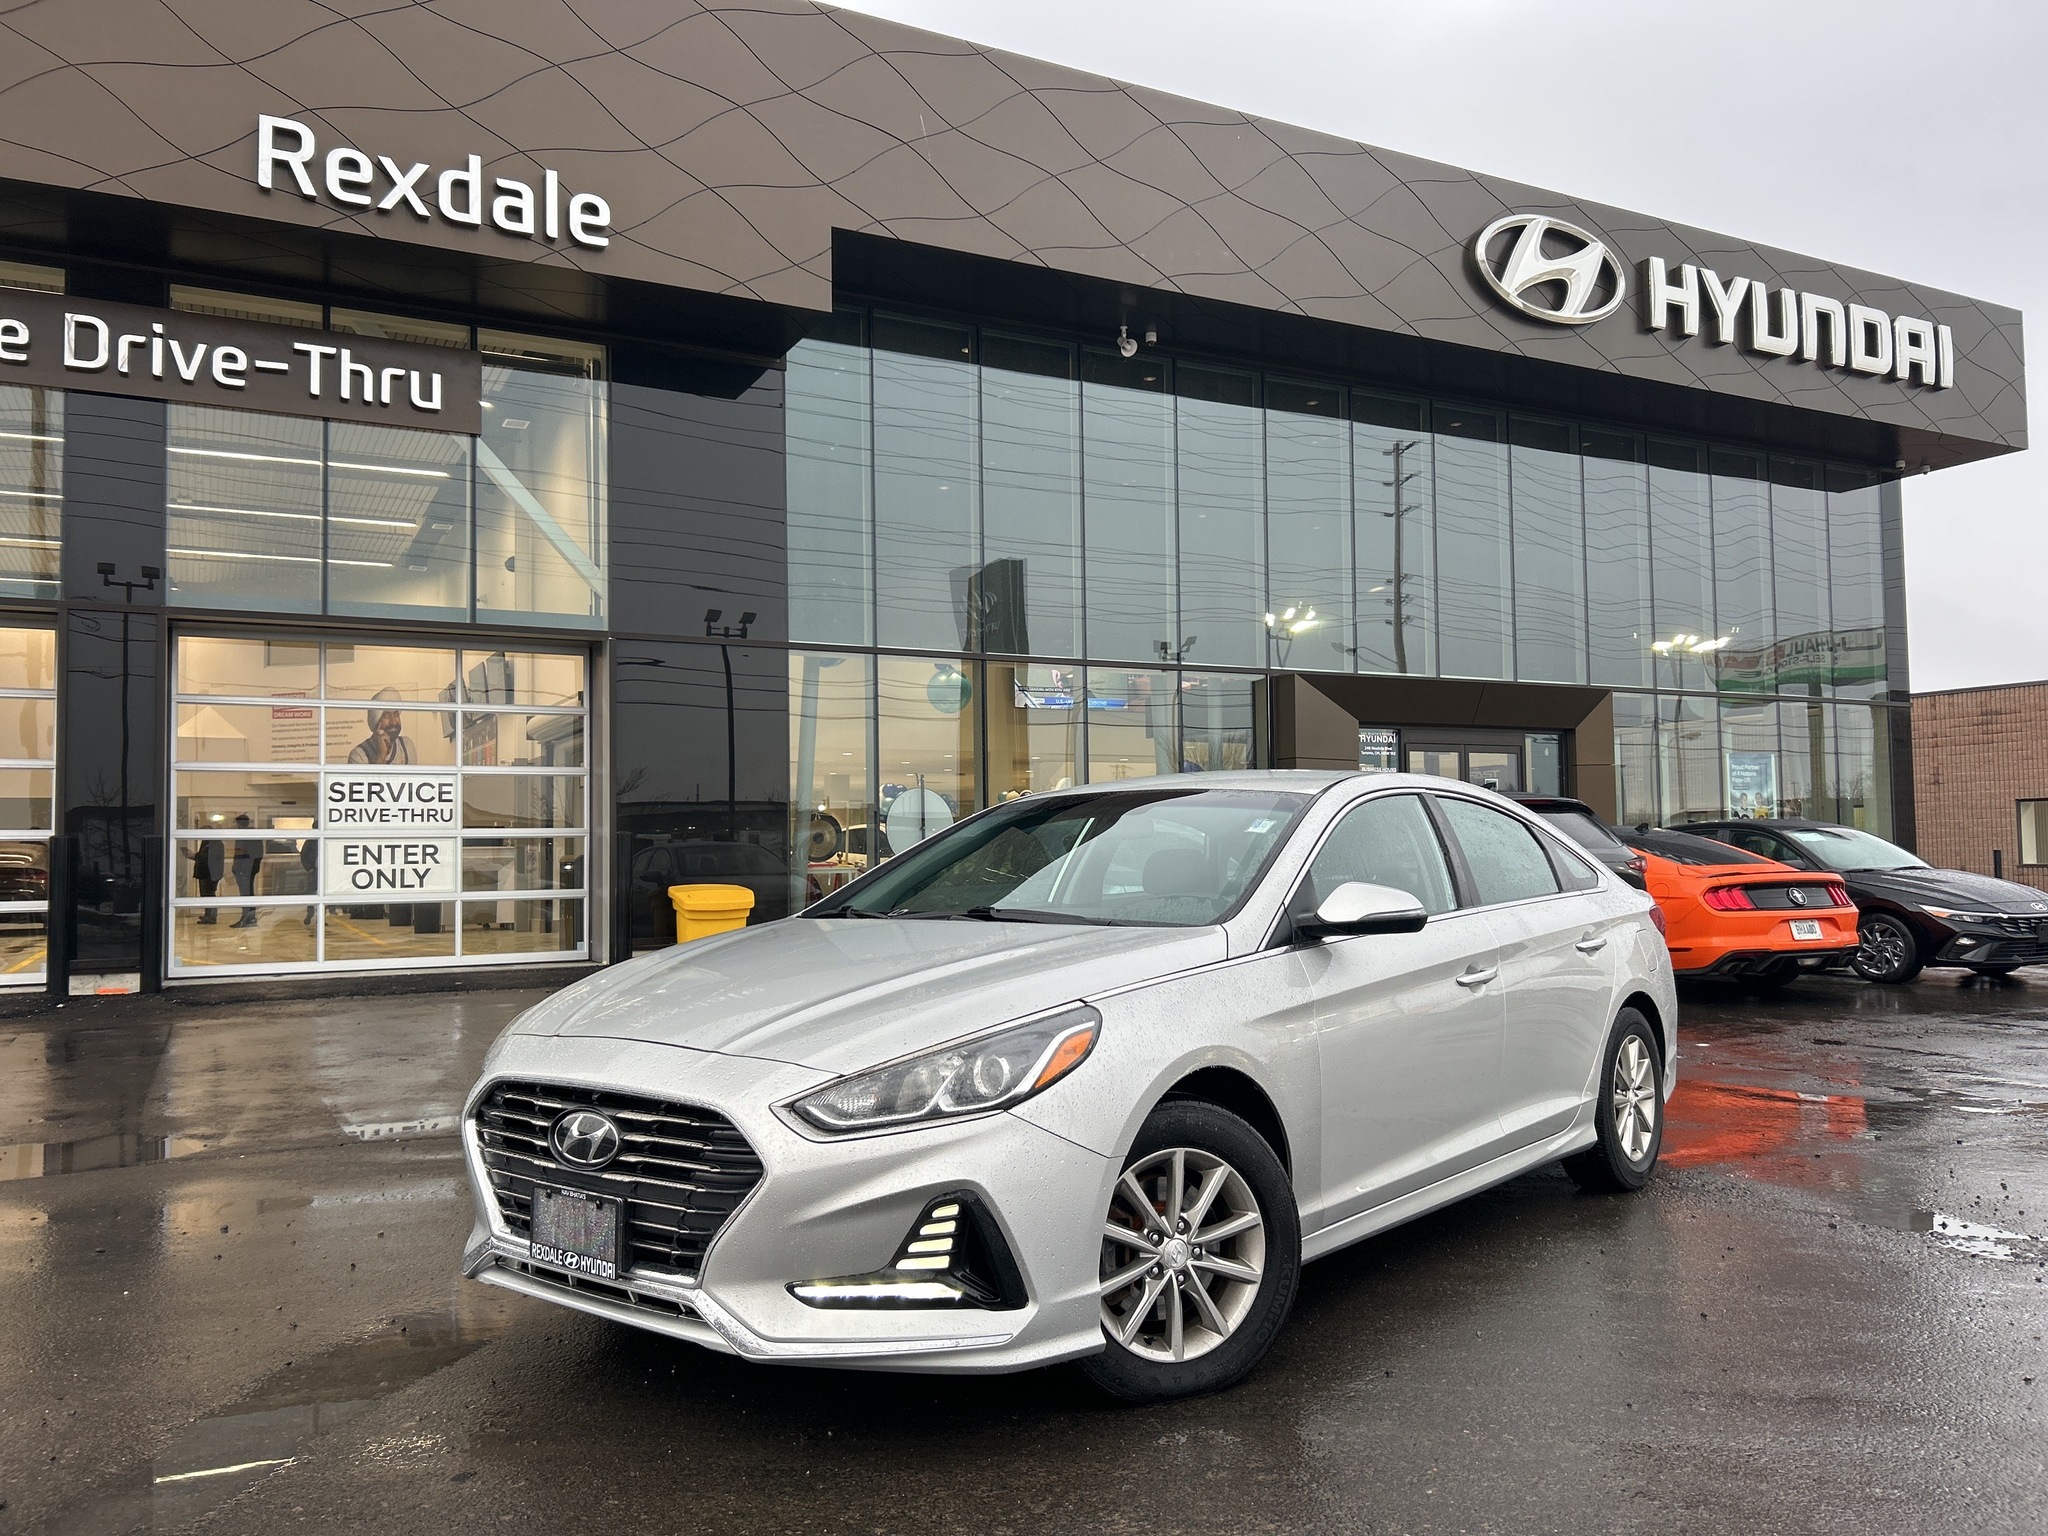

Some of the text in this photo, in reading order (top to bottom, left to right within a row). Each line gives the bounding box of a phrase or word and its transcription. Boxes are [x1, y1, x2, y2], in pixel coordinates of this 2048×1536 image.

[257, 112, 611, 249] Rexdale
[1646, 255, 1955, 390] HYUNDAI
[63, 311, 443, 411] Drive-Thru
[1360, 733, 1396, 743] HYUNDAI
[328, 781, 454, 803] SERVICE
[328, 808, 454, 823] DRIVE-THRU
[343, 844, 440, 865] ENTER
[351, 868, 431, 890] ONLY
[531, 1242, 616, 1280] REXDALE HYUNDAI
